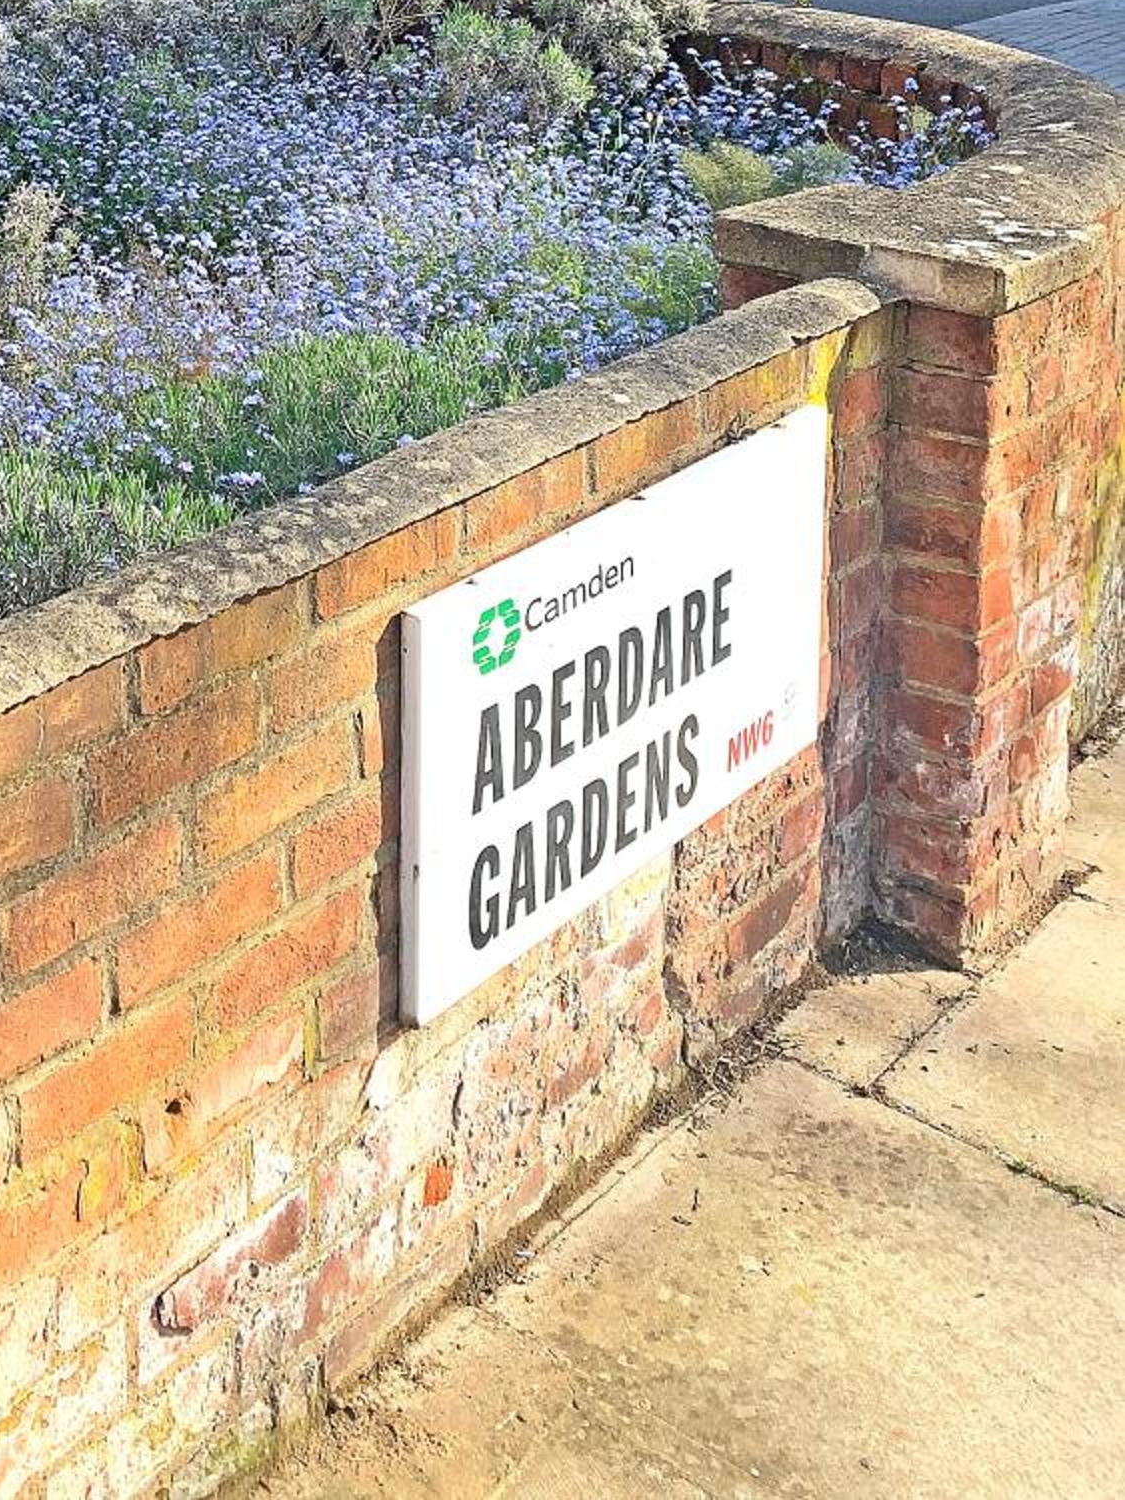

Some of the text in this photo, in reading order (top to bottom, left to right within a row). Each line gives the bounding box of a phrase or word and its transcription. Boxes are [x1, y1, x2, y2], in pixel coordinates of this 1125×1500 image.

[472, 569, 732, 816] ABERDARE
[525, 556, 634, 632] Camden
[468, 710, 774, 950] GARDENS NW6
